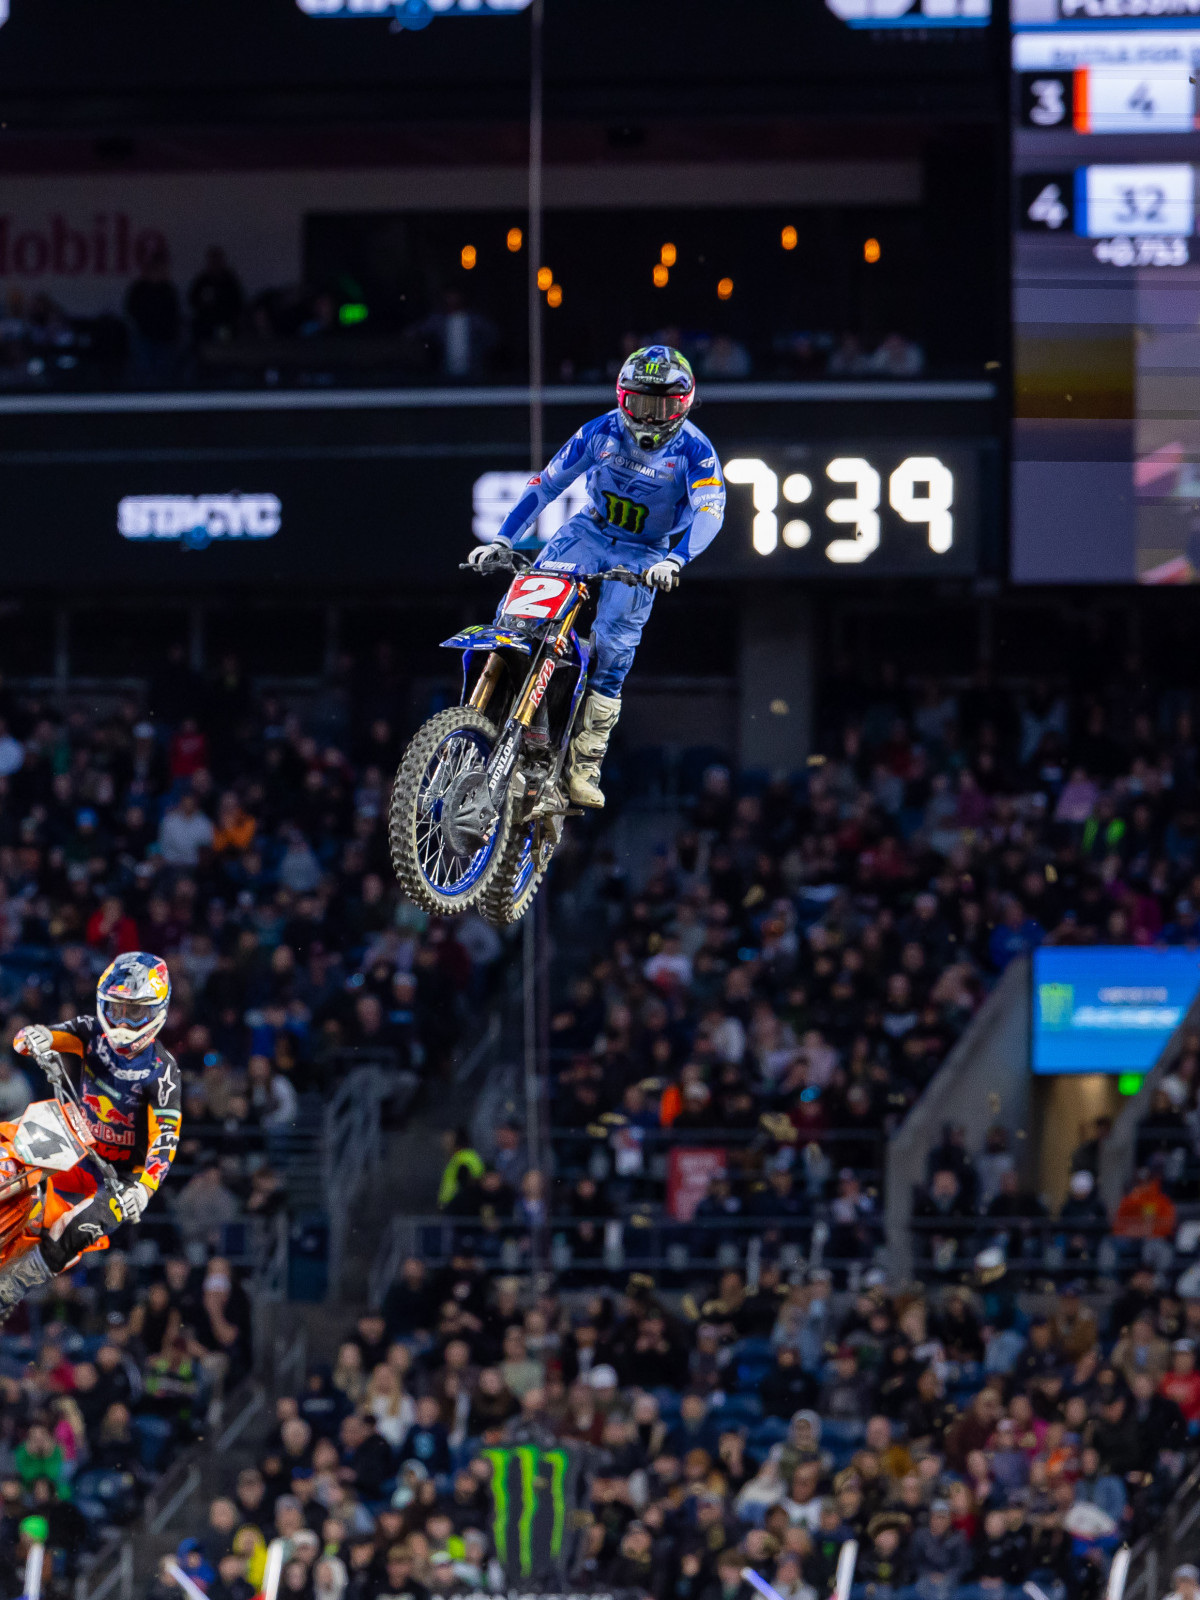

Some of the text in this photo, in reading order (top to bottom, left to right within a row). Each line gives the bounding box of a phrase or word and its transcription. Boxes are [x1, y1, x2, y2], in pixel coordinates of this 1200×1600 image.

[1030, 79, 1065, 125] 3
[1028, 183, 1069, 229] 4
[624, 458, 656, 479] YAMAHA
[723, 455, 954, 563] 7:39
[504, 577, 566, 618] 2
[488, 736, 514, 791] DUNLOP
[22, 1120, 70, 1160] 4
[102, 1123, 136, 1147] Bull
